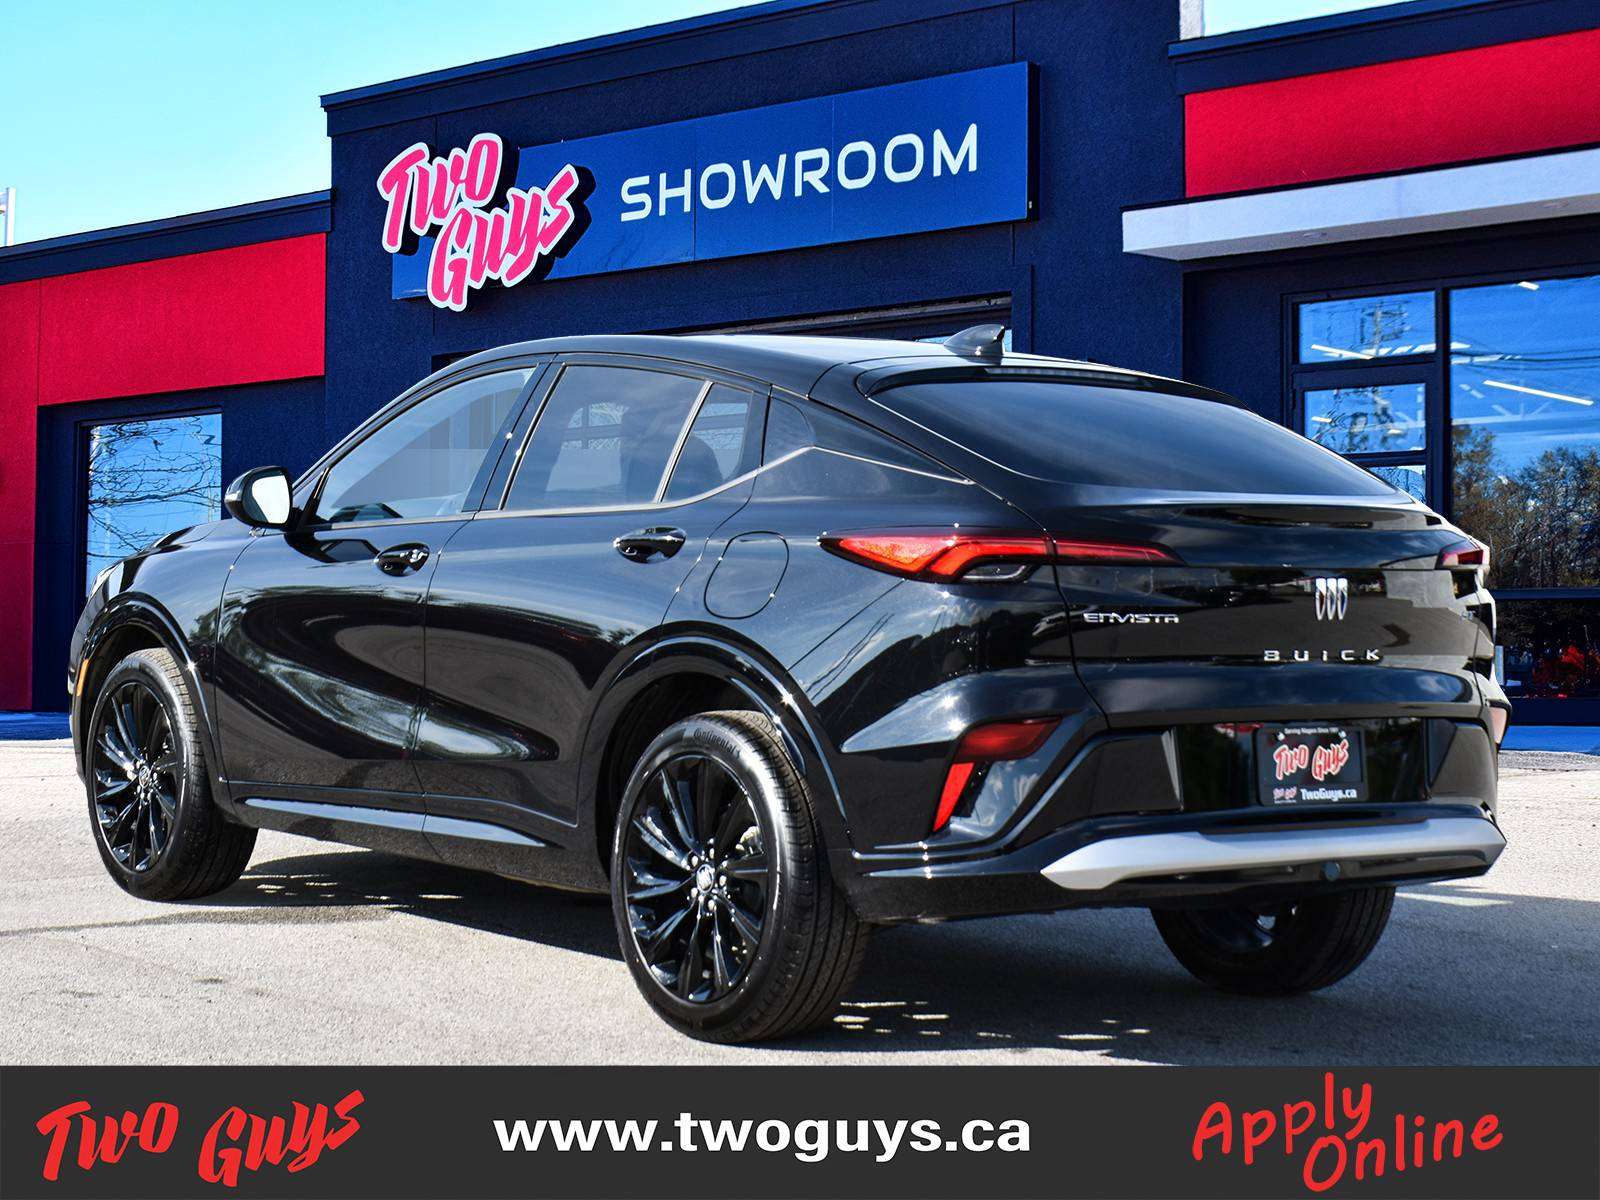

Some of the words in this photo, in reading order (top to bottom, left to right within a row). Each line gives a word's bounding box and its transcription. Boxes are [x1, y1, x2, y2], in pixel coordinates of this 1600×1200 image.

[379, 134, 502, 251] Two
[620, 123, 978, 222] SHOWROOM
[429, 167, 577, 309] Guys
[1083, 612, 1180, 624] ENVISTA
[1263, 648, 1381, 663] BUICK
[1273, 744, 1309, 781] Two
[1311, 739, 1349, 781] Guys
[1300, 787, 1357, 802] TwoGuys.ca
